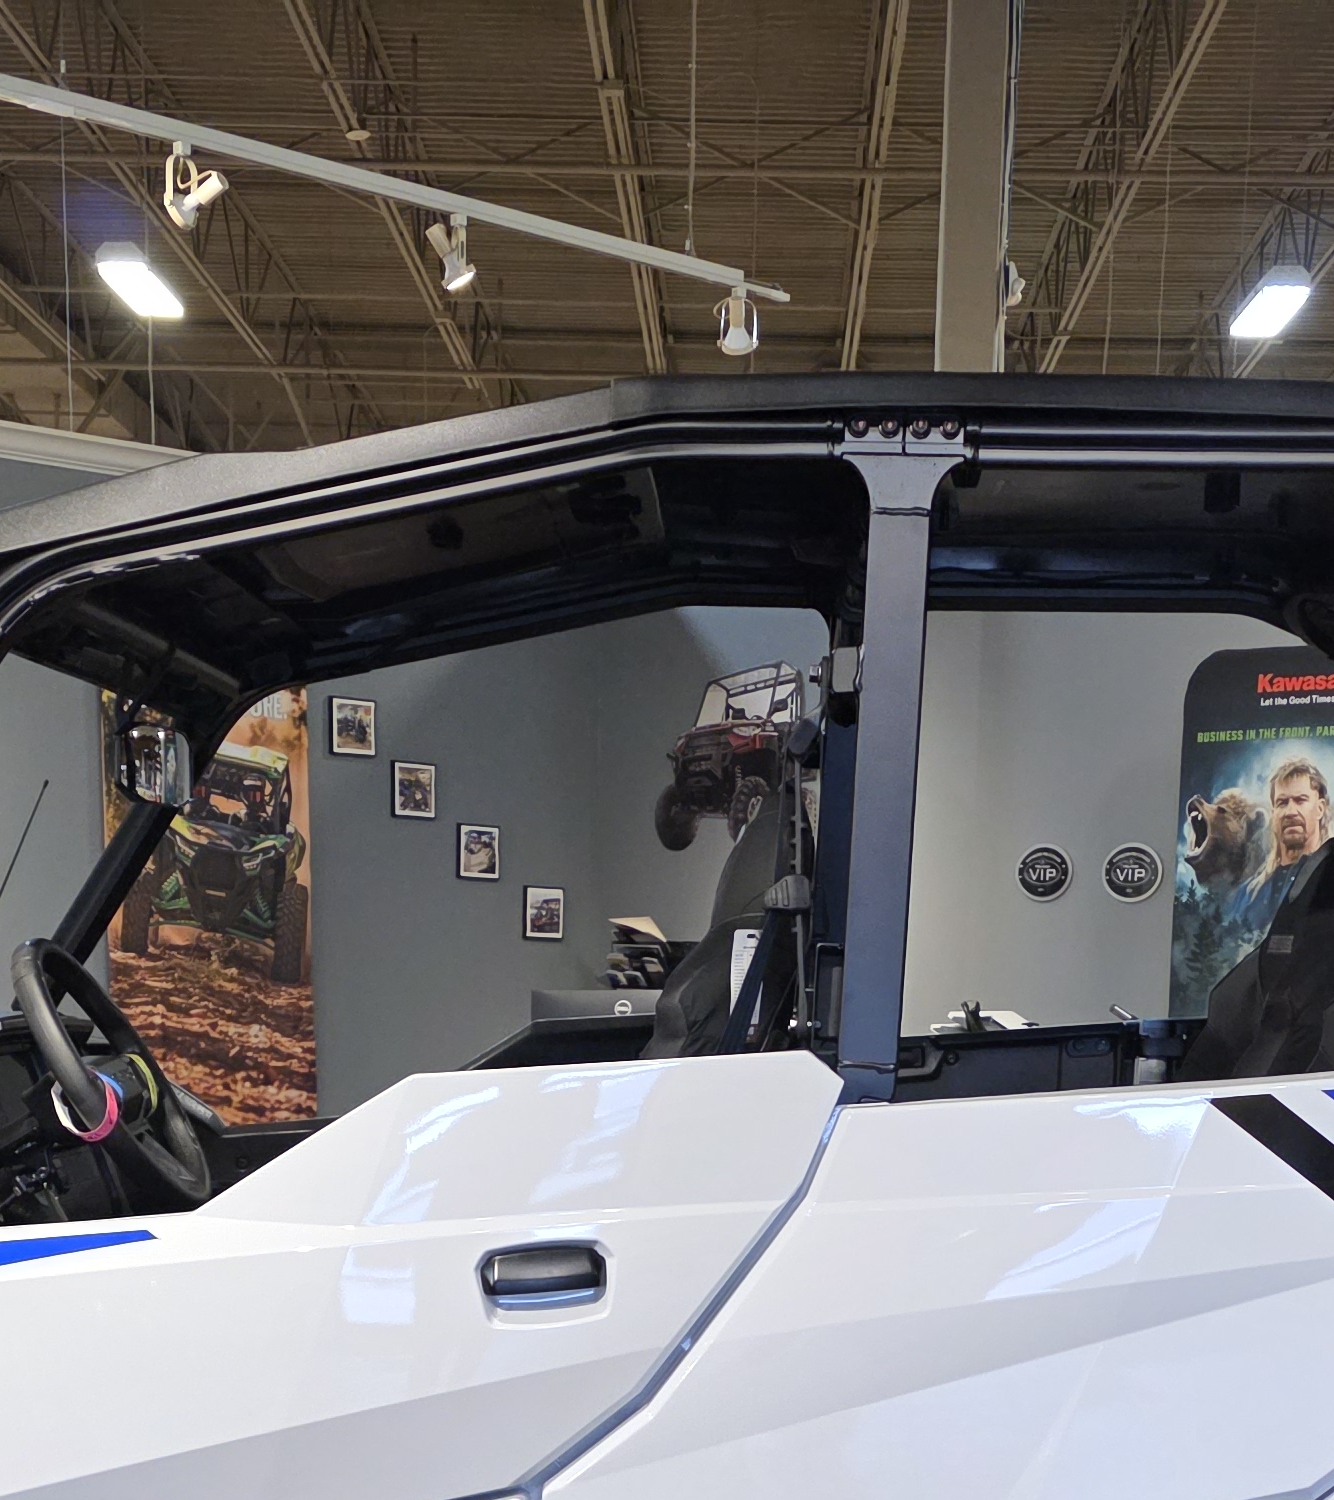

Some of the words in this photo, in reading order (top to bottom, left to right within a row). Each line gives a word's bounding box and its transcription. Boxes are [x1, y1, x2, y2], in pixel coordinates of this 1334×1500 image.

[1260, 698, 1273, 706] Let
[1275, 697, 1287, 705] the
[1289, 696, 1310, 704] Good
[1312, 695, 1334, 703] Times
[1197, 730, 1243, 742] BUSINESS
[1246, 729, 1256, 740] IN
[1258, 728, 1276, 739] THE
[1279, 726, 1313, 738] FRONT.
[1029, 868, 1056, 880] VIP
[1116, 868, 1146, 881] VIP
